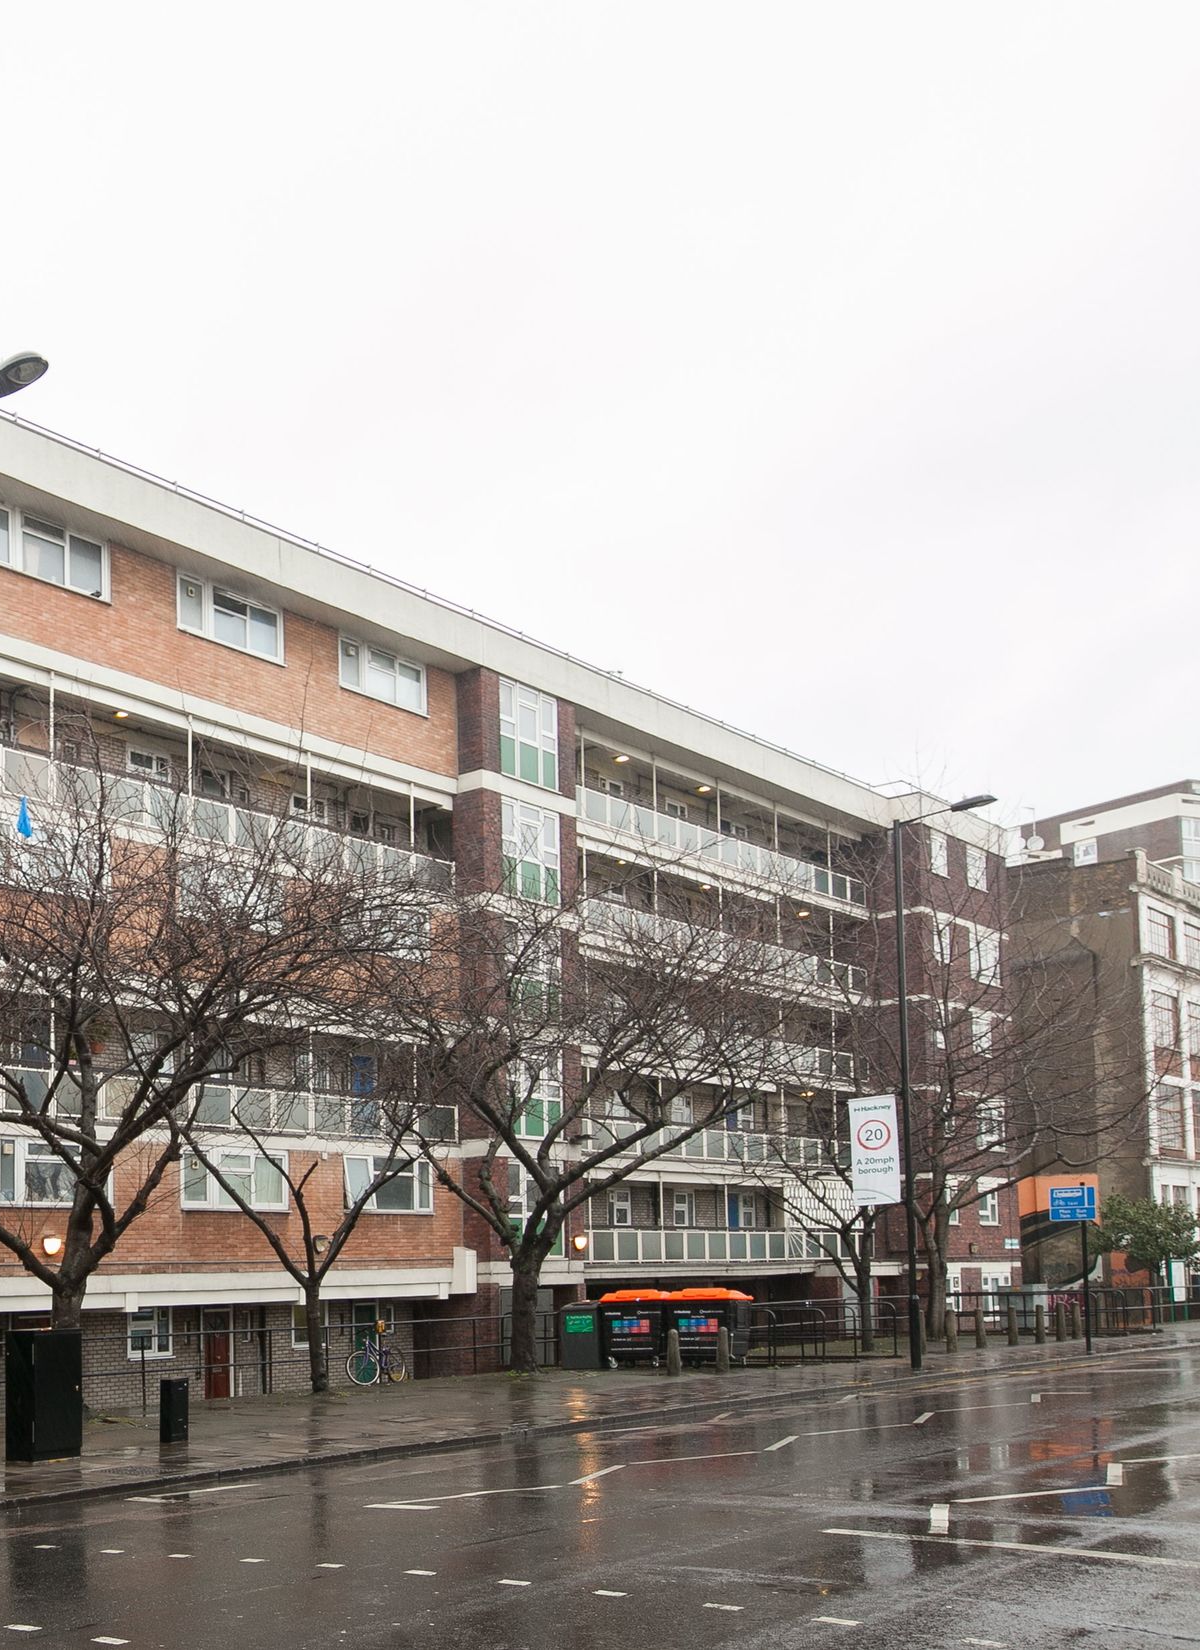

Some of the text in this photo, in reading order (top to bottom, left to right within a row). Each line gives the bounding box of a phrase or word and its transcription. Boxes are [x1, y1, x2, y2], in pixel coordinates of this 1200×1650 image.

[861, 1104, 891, 1112] Hackney
[865, 1128, 883, 1141] 20
[856, 1156, 895, 1166] A 20mph
[858, 1165, 894, 1175] borough
